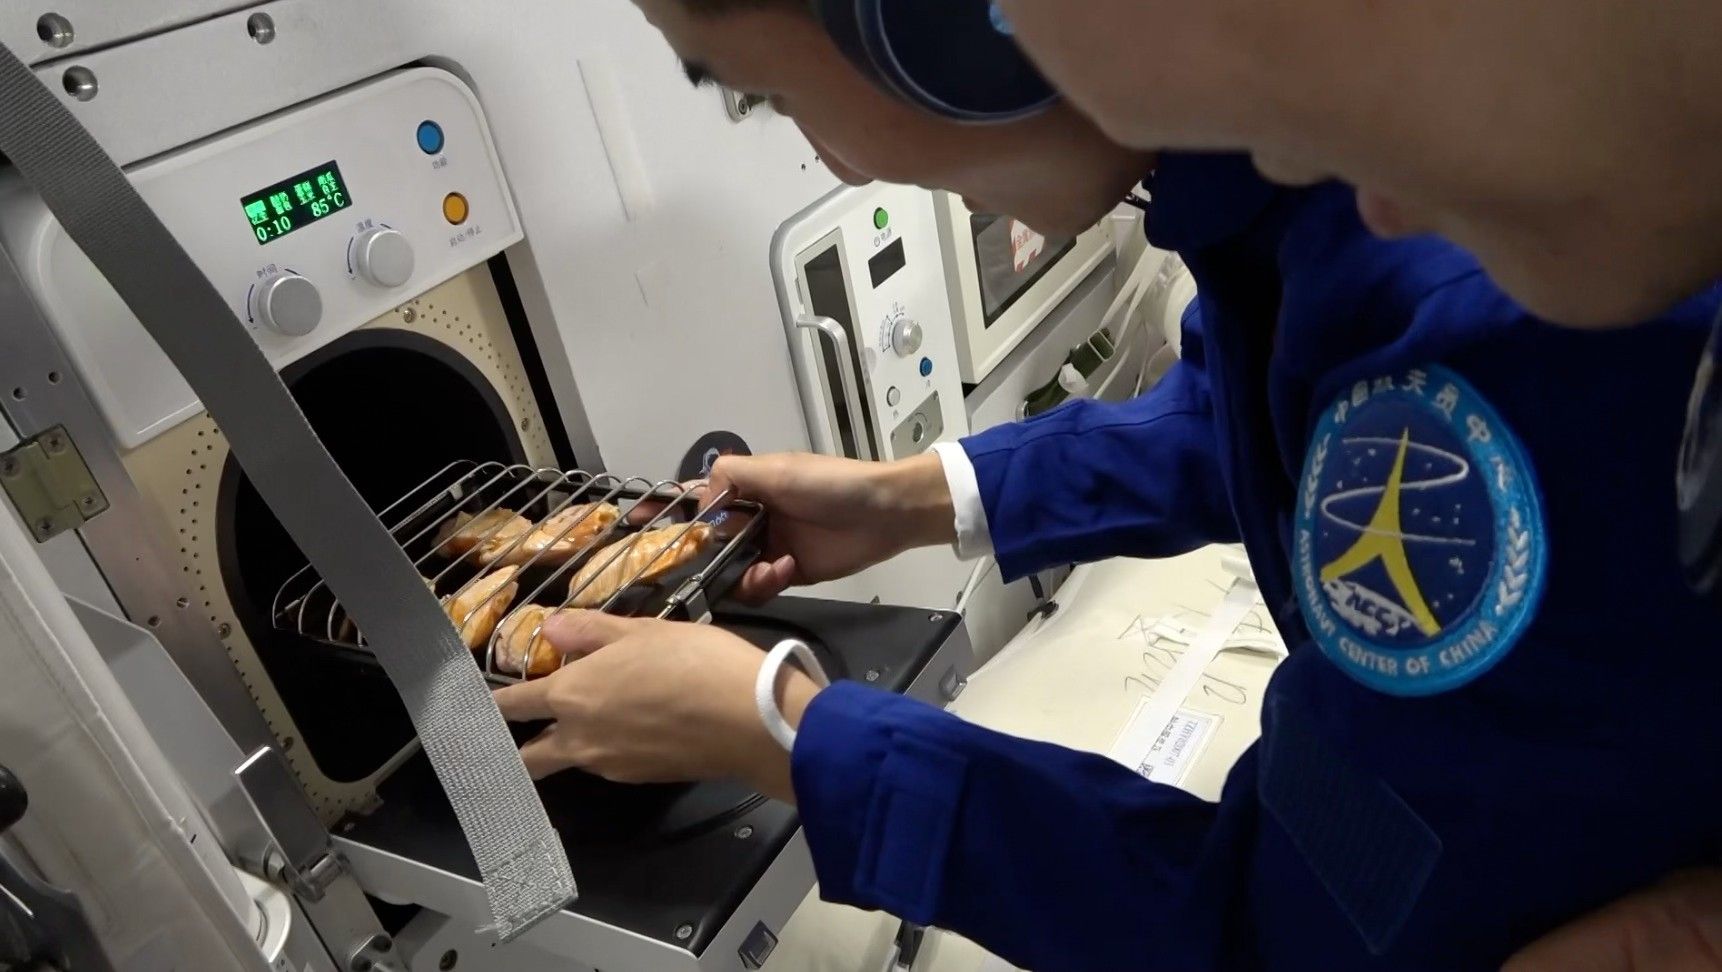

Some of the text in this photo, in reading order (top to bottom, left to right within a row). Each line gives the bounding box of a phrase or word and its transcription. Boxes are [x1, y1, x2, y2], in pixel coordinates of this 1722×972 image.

[256, 216, 291, 242] 0:10
[1338, 636, 1398, 677] CENTER
[1405, 655, 1431, 676] OF
[1438, 619, 1499, 668] CHINA
